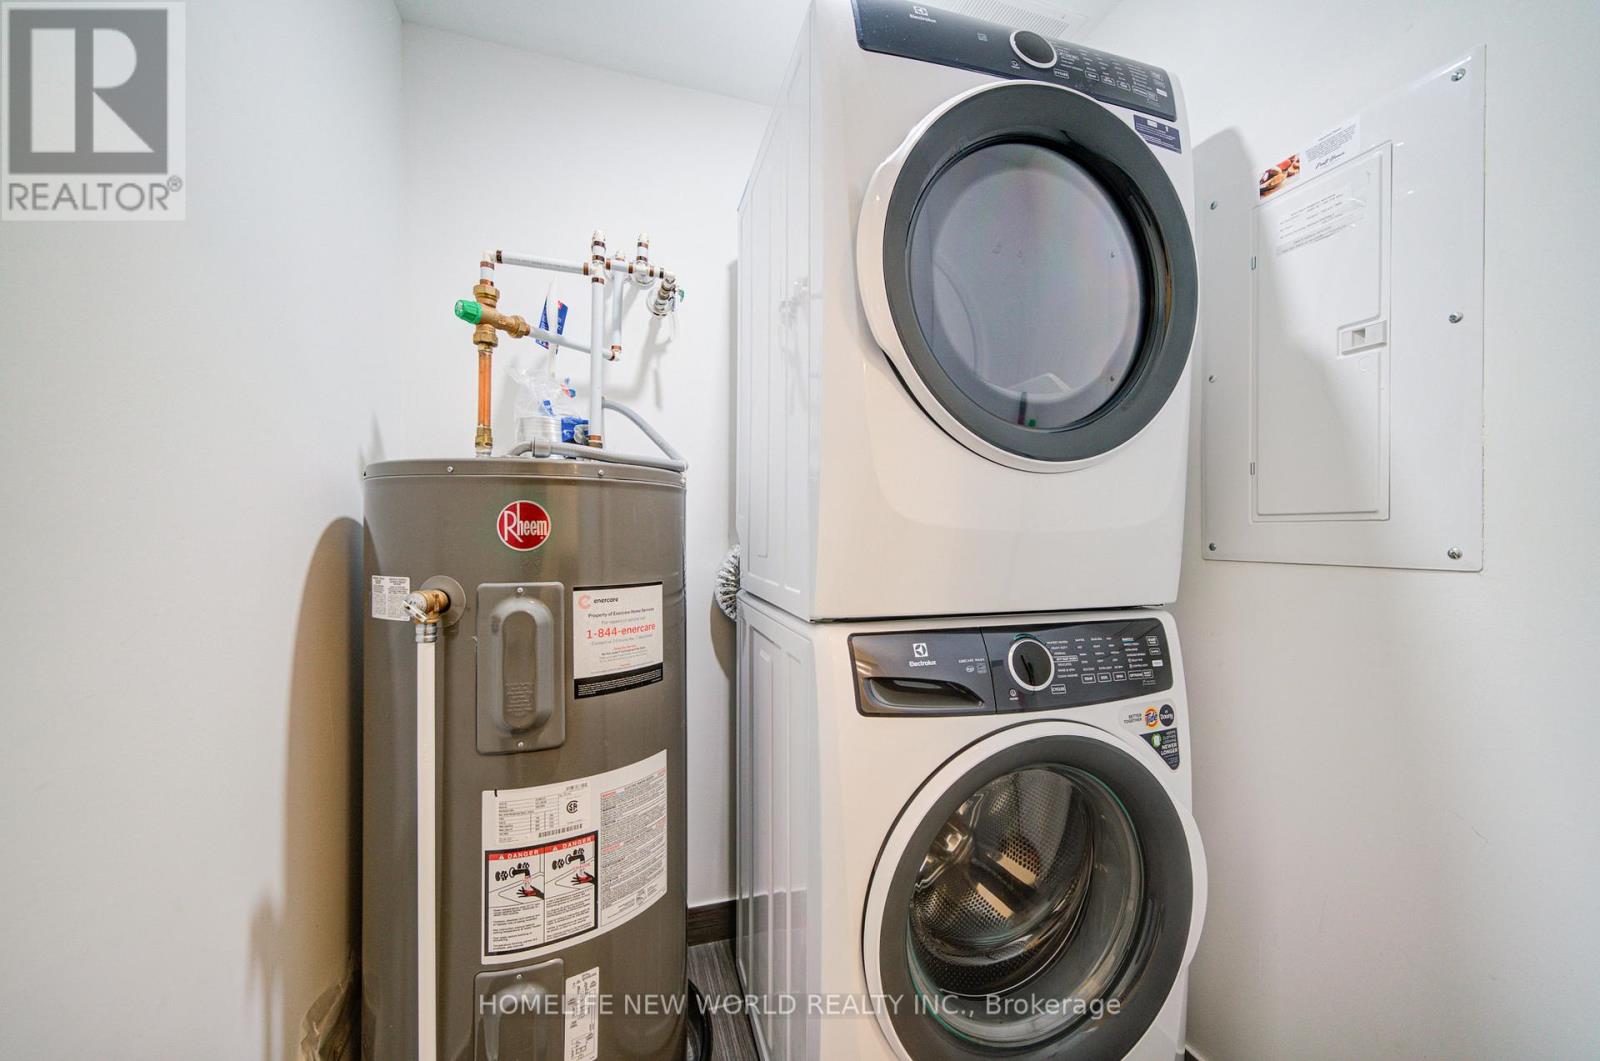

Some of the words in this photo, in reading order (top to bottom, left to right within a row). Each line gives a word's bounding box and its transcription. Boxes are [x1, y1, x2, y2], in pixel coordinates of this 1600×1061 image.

[503, 501, 548, 543] Rheem
[586, 623, 656, 639] 1-844-enercare
[562, 836, 593, 849] DANGER
[507, 849, 539, 859] DANGER
